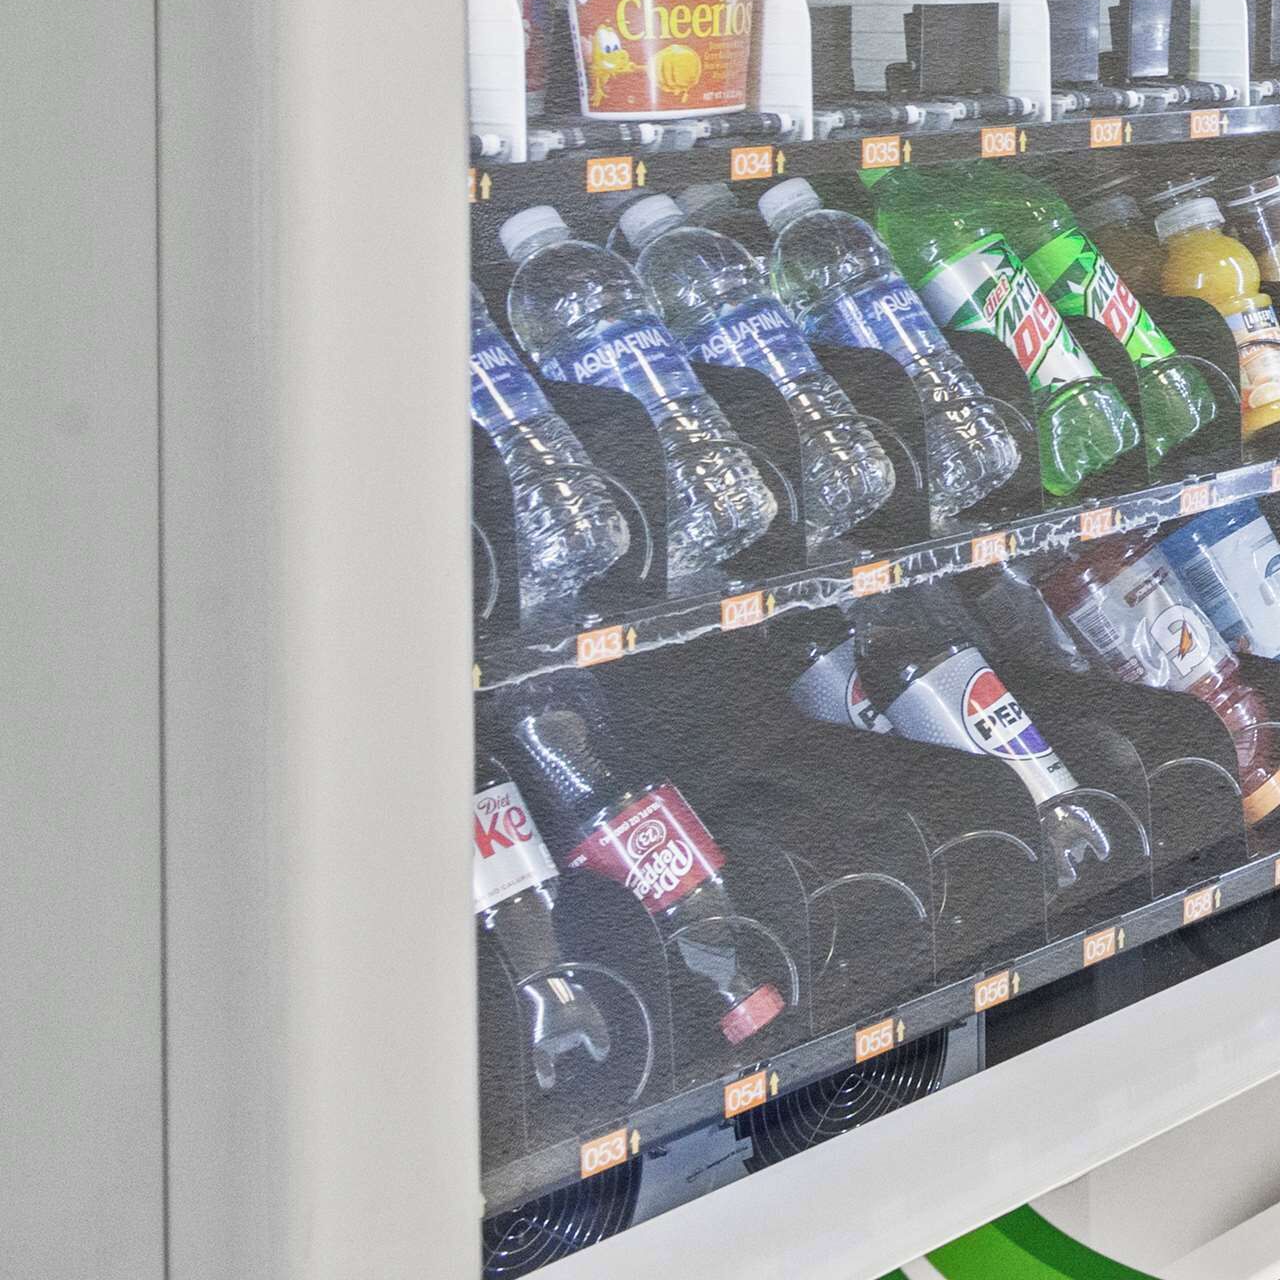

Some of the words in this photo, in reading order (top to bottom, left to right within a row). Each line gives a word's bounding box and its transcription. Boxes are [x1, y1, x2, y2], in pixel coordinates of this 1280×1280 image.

[984, 132, 1016, 154] 036
[1092, 121, 1122, 145] 037
[733, 151, 772, 177] 034
[864, 139, 899, 165] 035
[590, 162, 632, 188] 033
[700, 309, 790, 364] AQUAFINA
[572, 328, 671, 384] AQUAFINA
[724, 597, 763, 624] 044
[580, 631, 622, 663] 043
[973, 701, 1025, 742] PEP
[474, 805, 533, 859] ke
[652, 867, 681, 899] Dr
[1185, 887, 1213, 916] 058
[1085, 932, 1115, 961] 057
[975, 974, 1009, 1006] 056
[857, 1024, 894, 1058] 055
[726, 1077, 766, 1113] 054
[584, 1133, 627, 1172] 053
